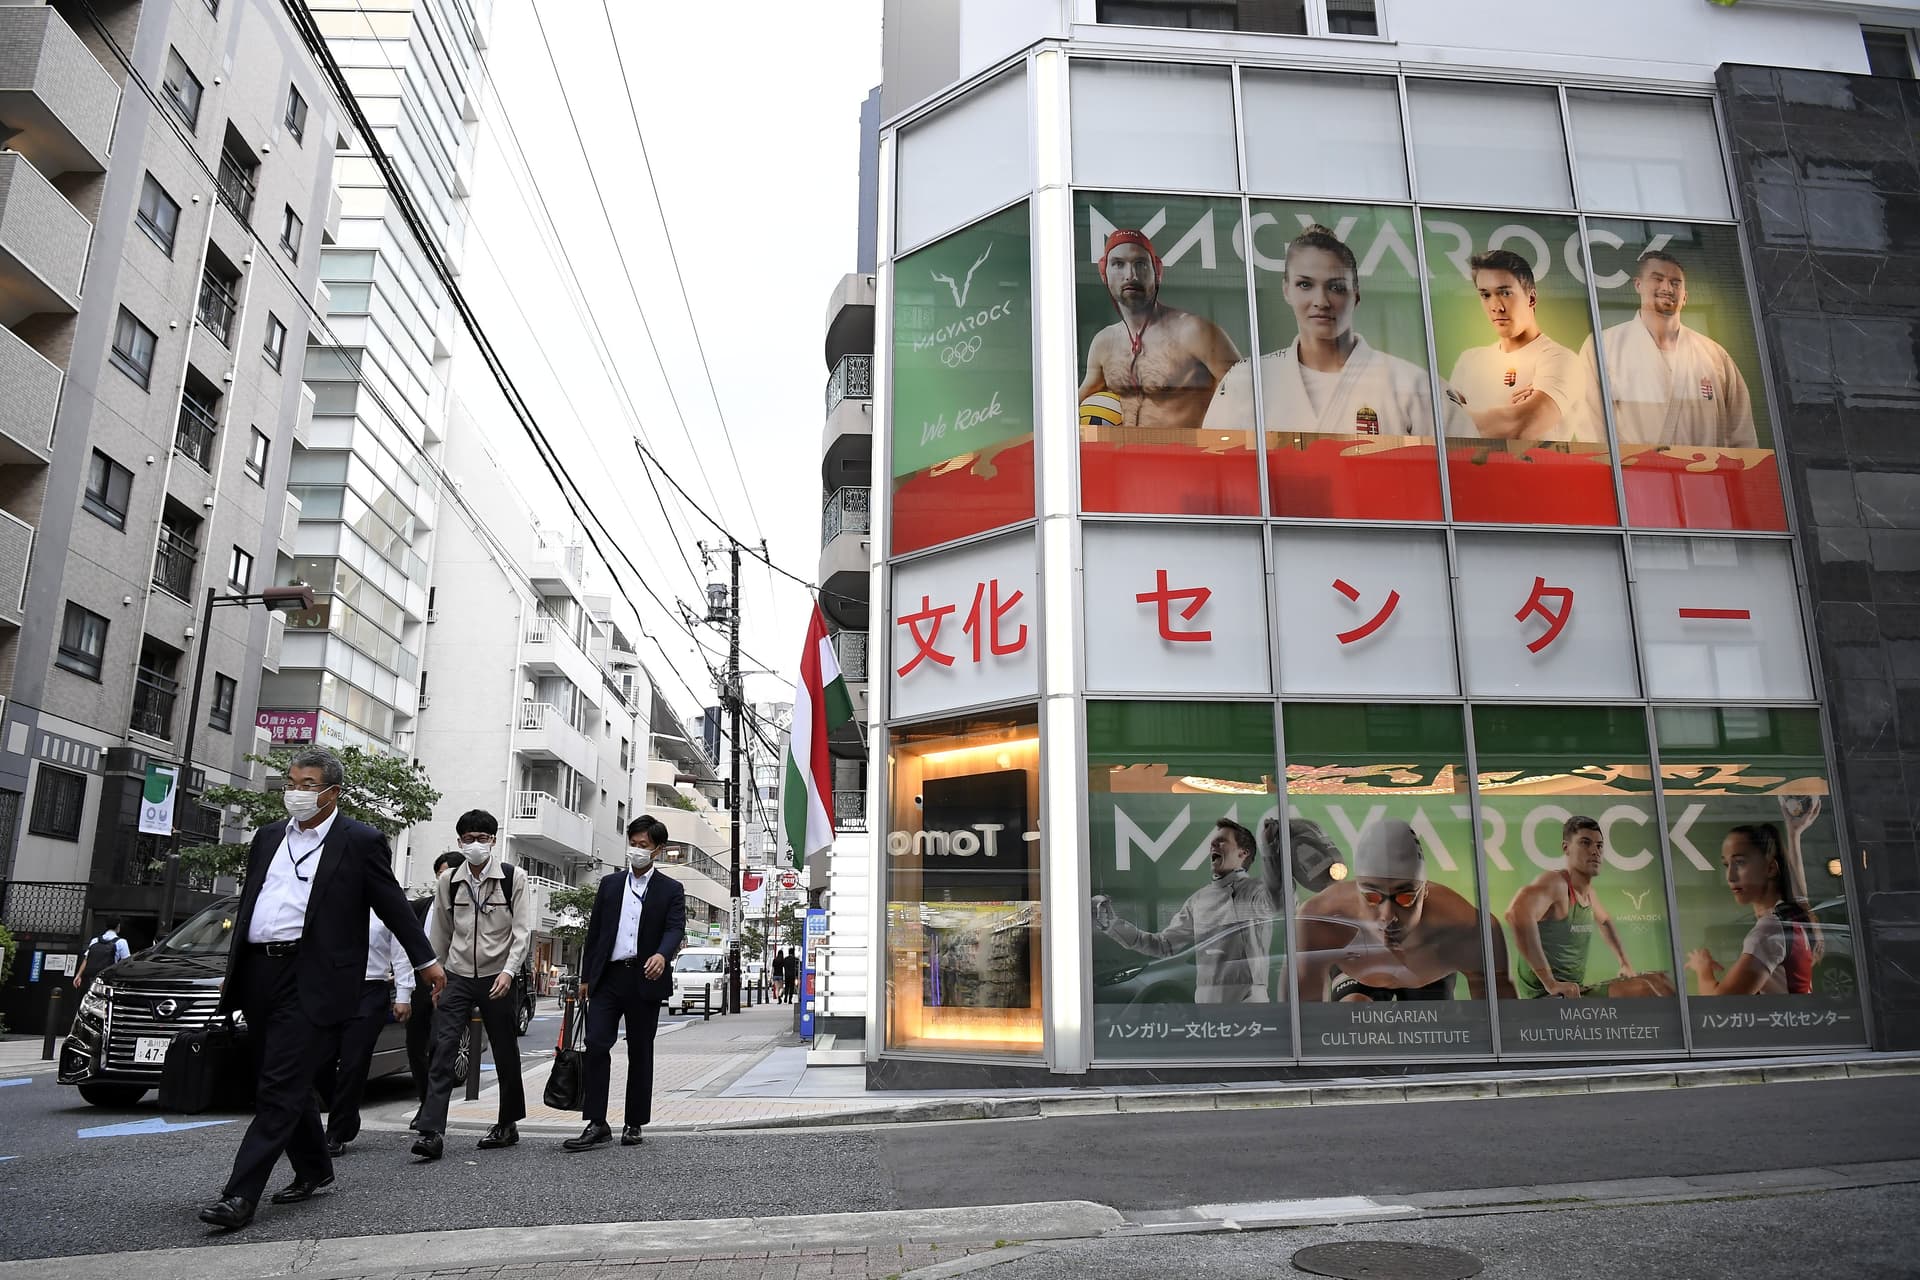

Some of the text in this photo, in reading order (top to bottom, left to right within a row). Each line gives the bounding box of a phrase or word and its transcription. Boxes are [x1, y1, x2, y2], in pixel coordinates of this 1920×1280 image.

[913, 300, 1012, 352] MAGYAROCK
[920, 391, 1004, 447] We Rock
[261, 726, 313, 740] 児教室
[1351, 1010, 1438, 1024] HUNGARIAN
[1560, 1007, 1618, 1020] MAGYAR
[1702, 1010, 1851, 1029] ハンガリー文化センター
[1108, 1021, 1278, 1039] ハンガリー文化センター
[1321, 1030, 1471, 1046] CULTURAL INSTITUTE
[1520, 1023, 1660, 1042] KULTURÁLIS INTÉZET
